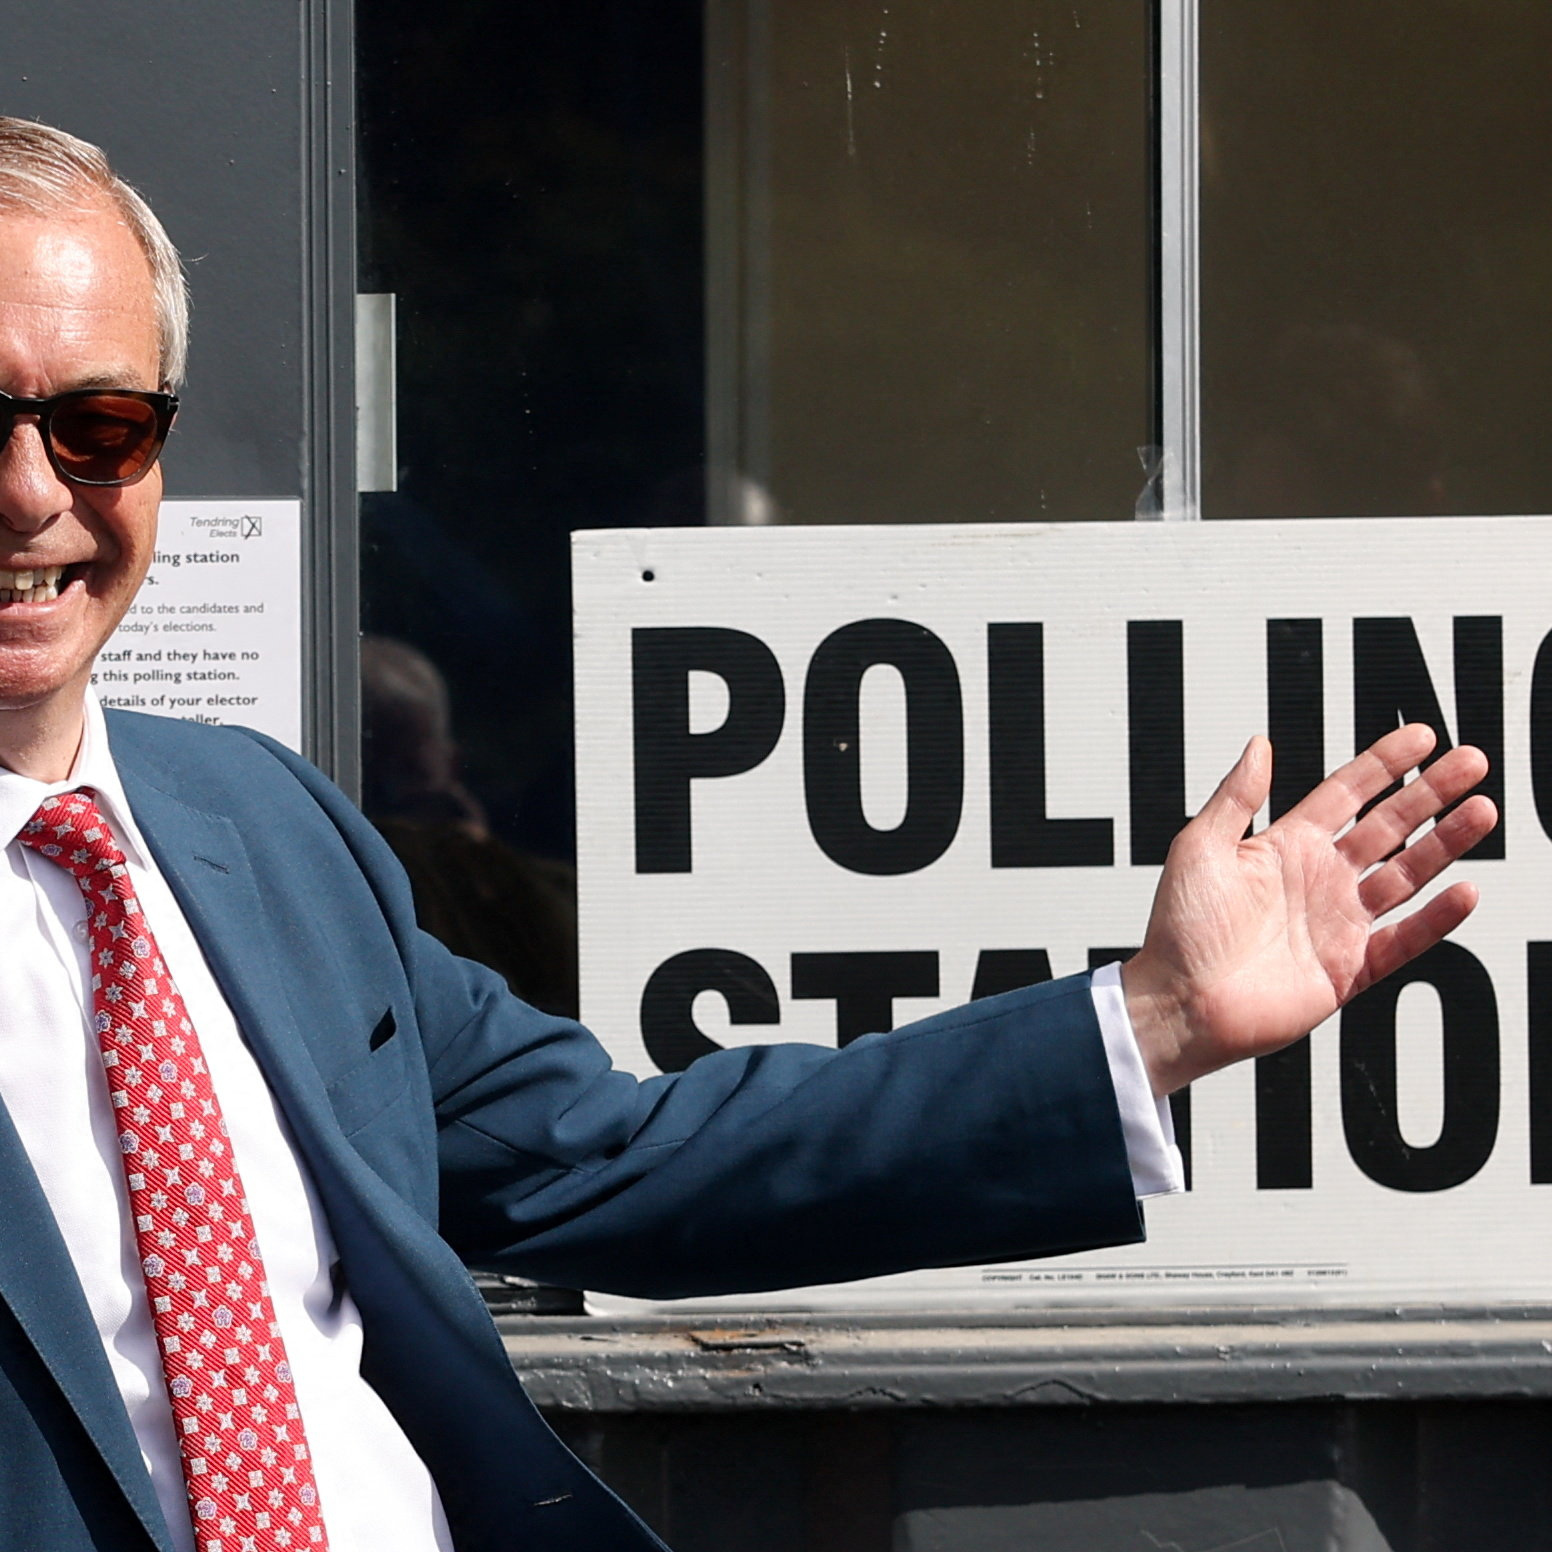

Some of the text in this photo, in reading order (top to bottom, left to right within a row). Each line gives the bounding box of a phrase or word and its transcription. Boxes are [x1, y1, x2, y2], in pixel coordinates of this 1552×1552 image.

[190, 516, 240, 529] Tendring
[209, 529, 237, 538] Elects
[186, 551, 240, 563] station
[141, 604, 153, 614] to
[157, 603, 176, 614] the
[179, 602, 240, 614] candidates
[243, 602, 264, 614] and
[118, 621, 216, 635] today's elections.
[101, 649, 259, 664] staff and they have no
[103, 669, 128, 681] this
[133, 669, 182, 684] polling
[186, 669, 240, 681] station.
[100, 694, 258, 709] details of your elector
